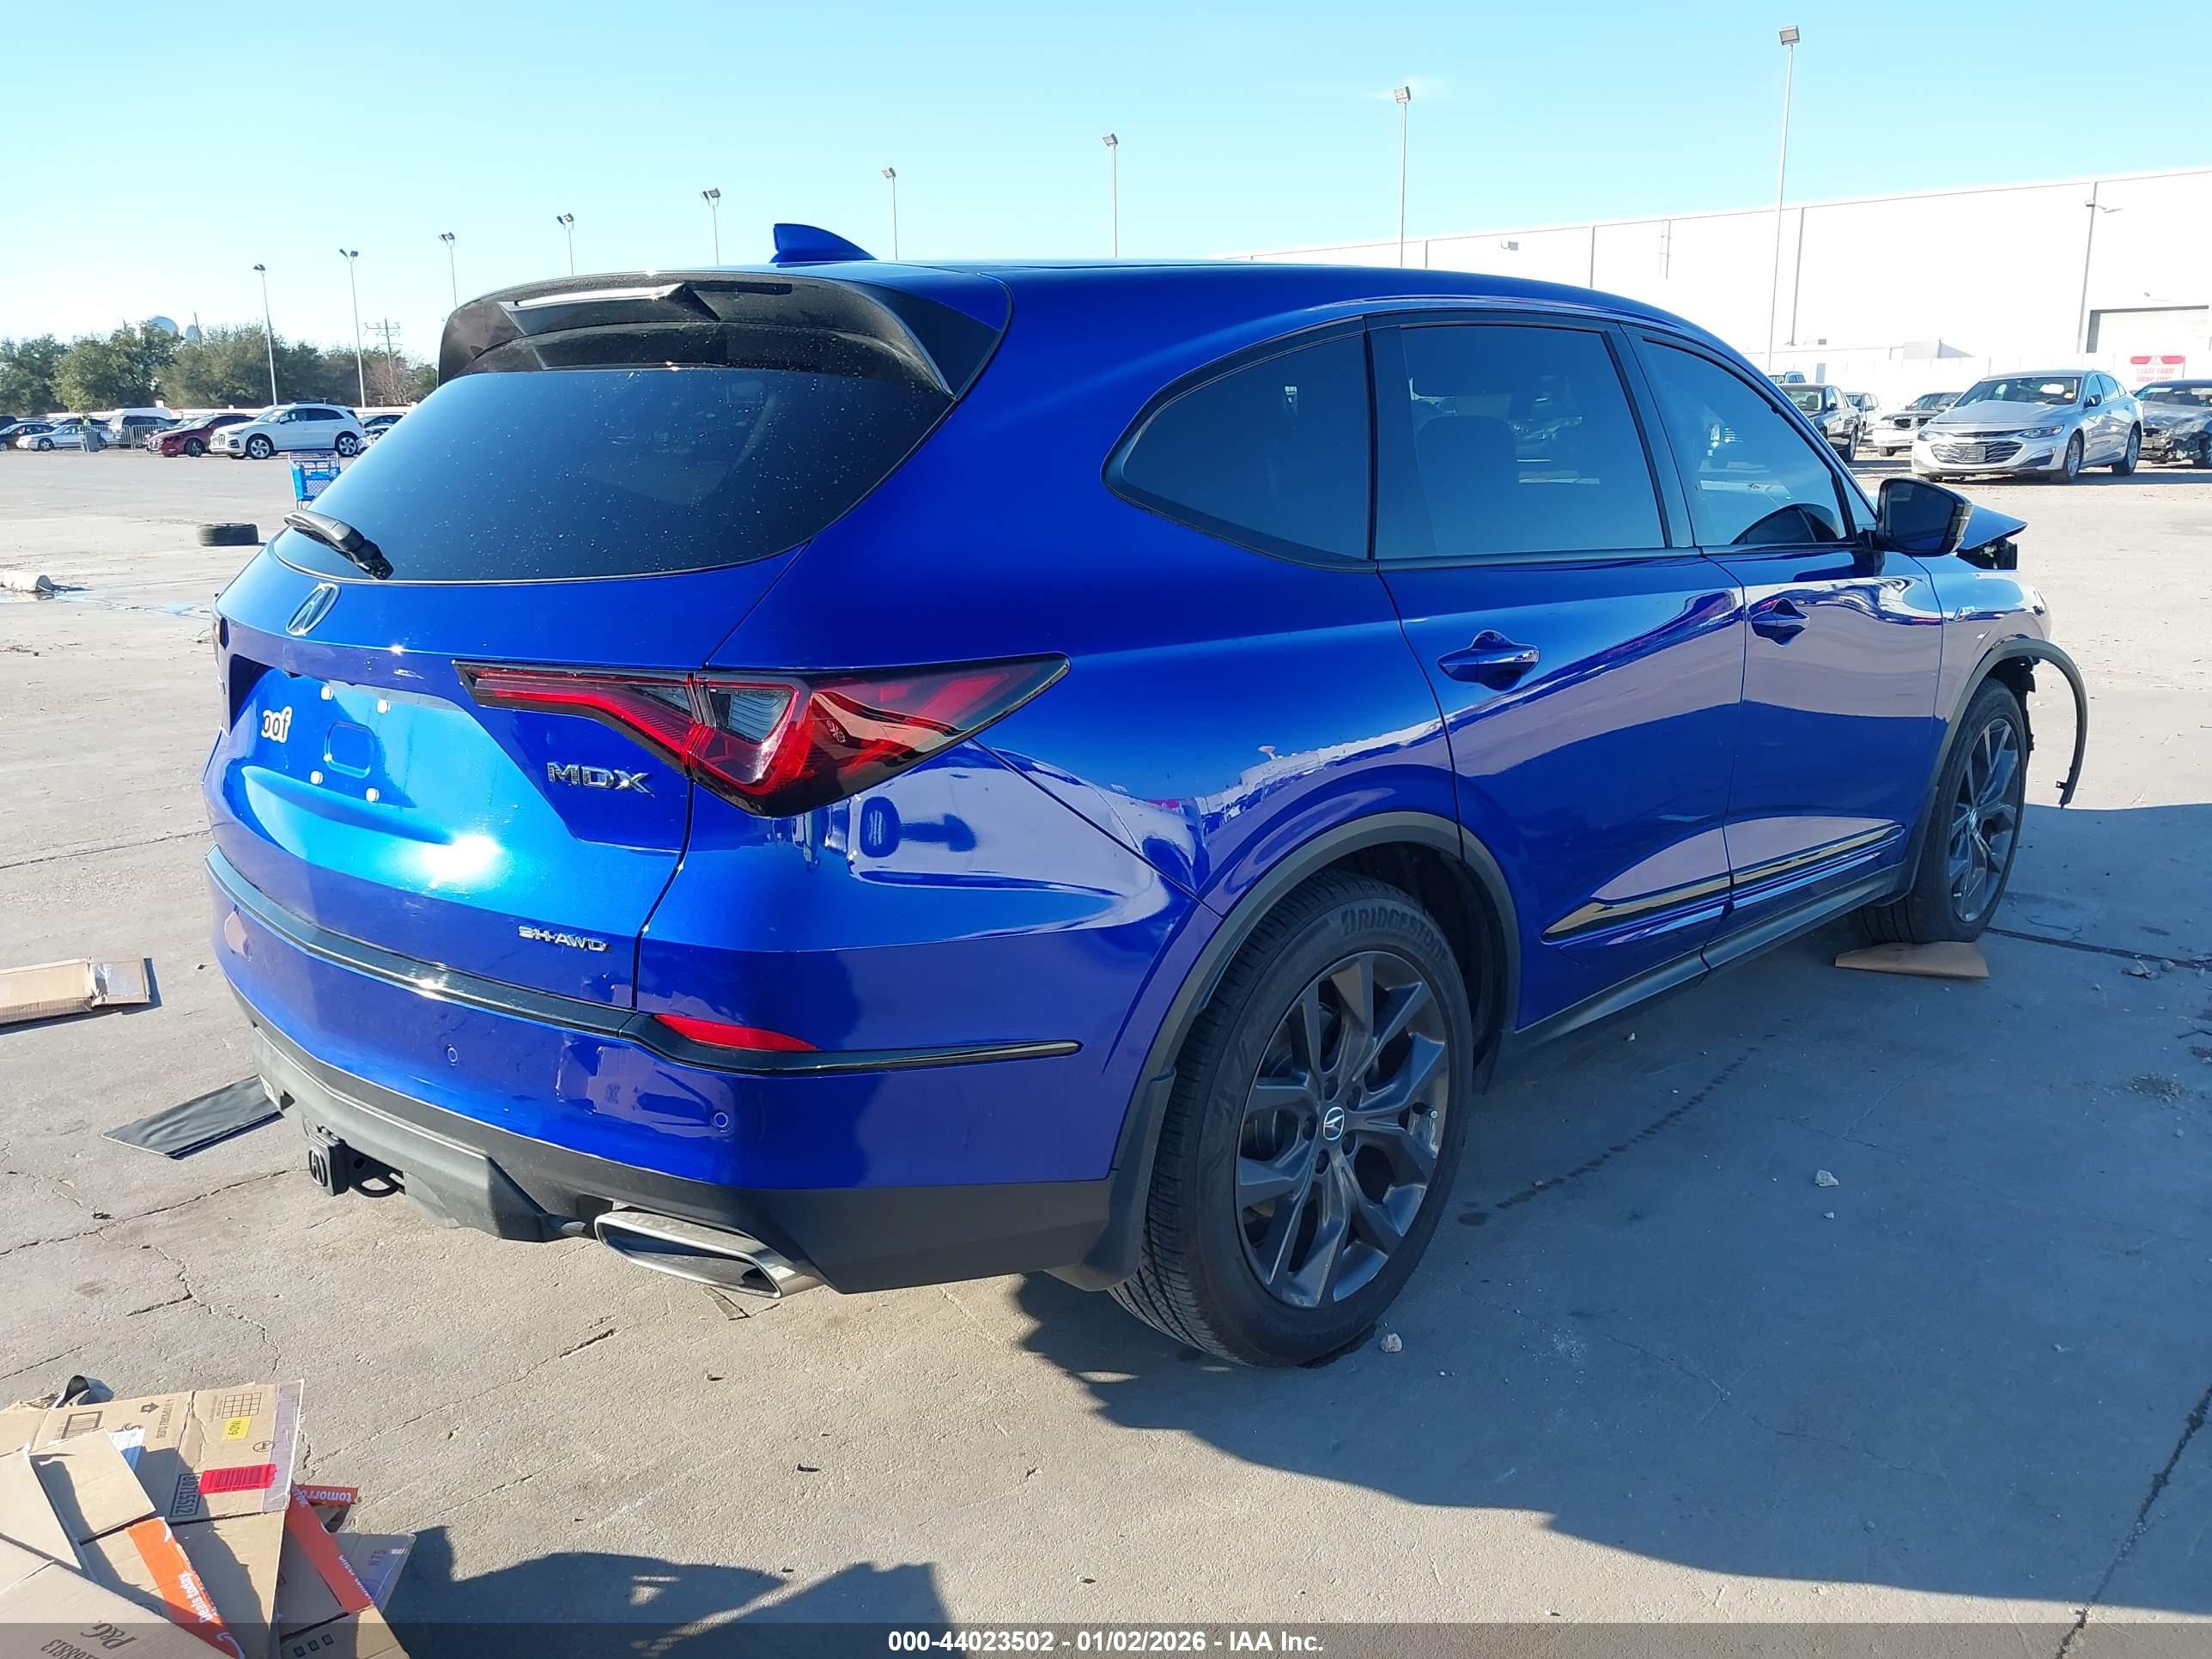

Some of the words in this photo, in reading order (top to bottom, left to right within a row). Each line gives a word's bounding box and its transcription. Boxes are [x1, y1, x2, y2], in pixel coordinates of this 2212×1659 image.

[546, 761, 653, 794] MDX
[518, 925, 607, 952] SH-AWD
[191, 1597, 214, 1623] Deals
